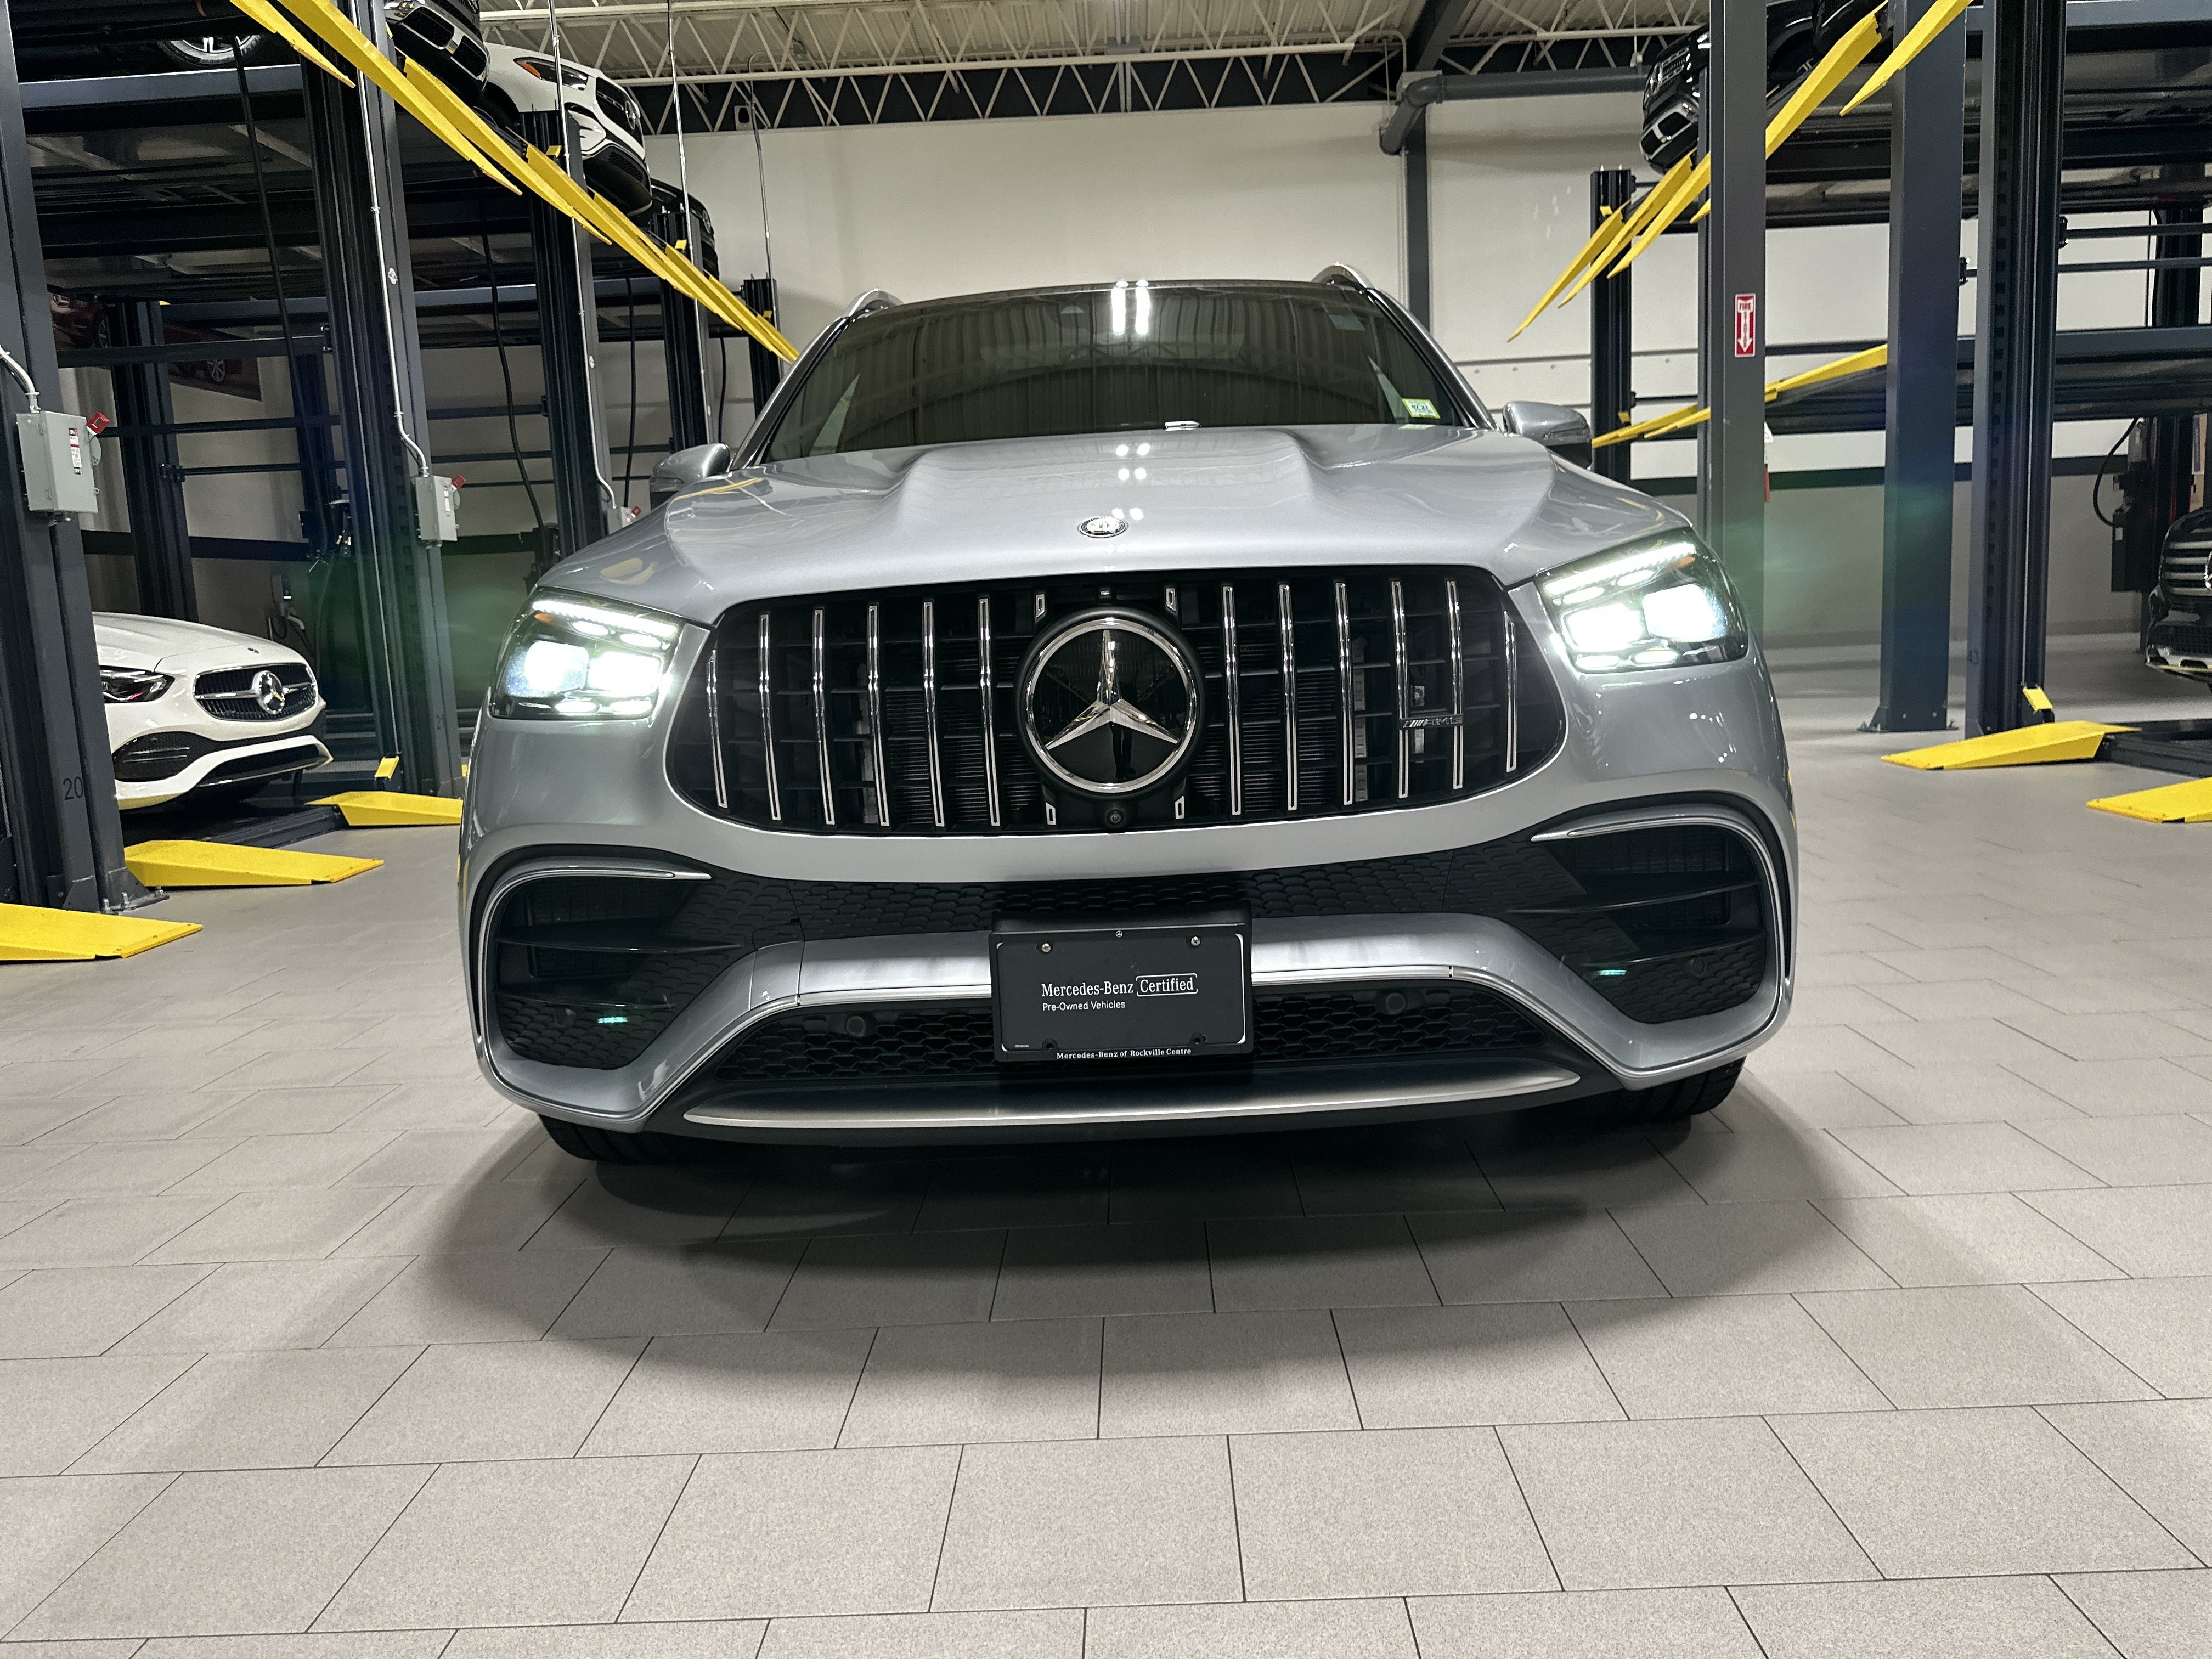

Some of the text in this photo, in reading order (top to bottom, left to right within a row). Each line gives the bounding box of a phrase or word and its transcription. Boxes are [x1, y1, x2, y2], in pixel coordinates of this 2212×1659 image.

[1739, 302, 1752, 311] FIRE
[63, 776, 84, 800] 20
[1041, 977, 1194, 997] Mercedes-Benz Certified
[1042, 1000, 1126, 1012] Pre-Owned Vehicles
[1057, 1051, 1118, 1059] Mercedes-Benz
[1130, 1048, 1165, 1057] Rockville
